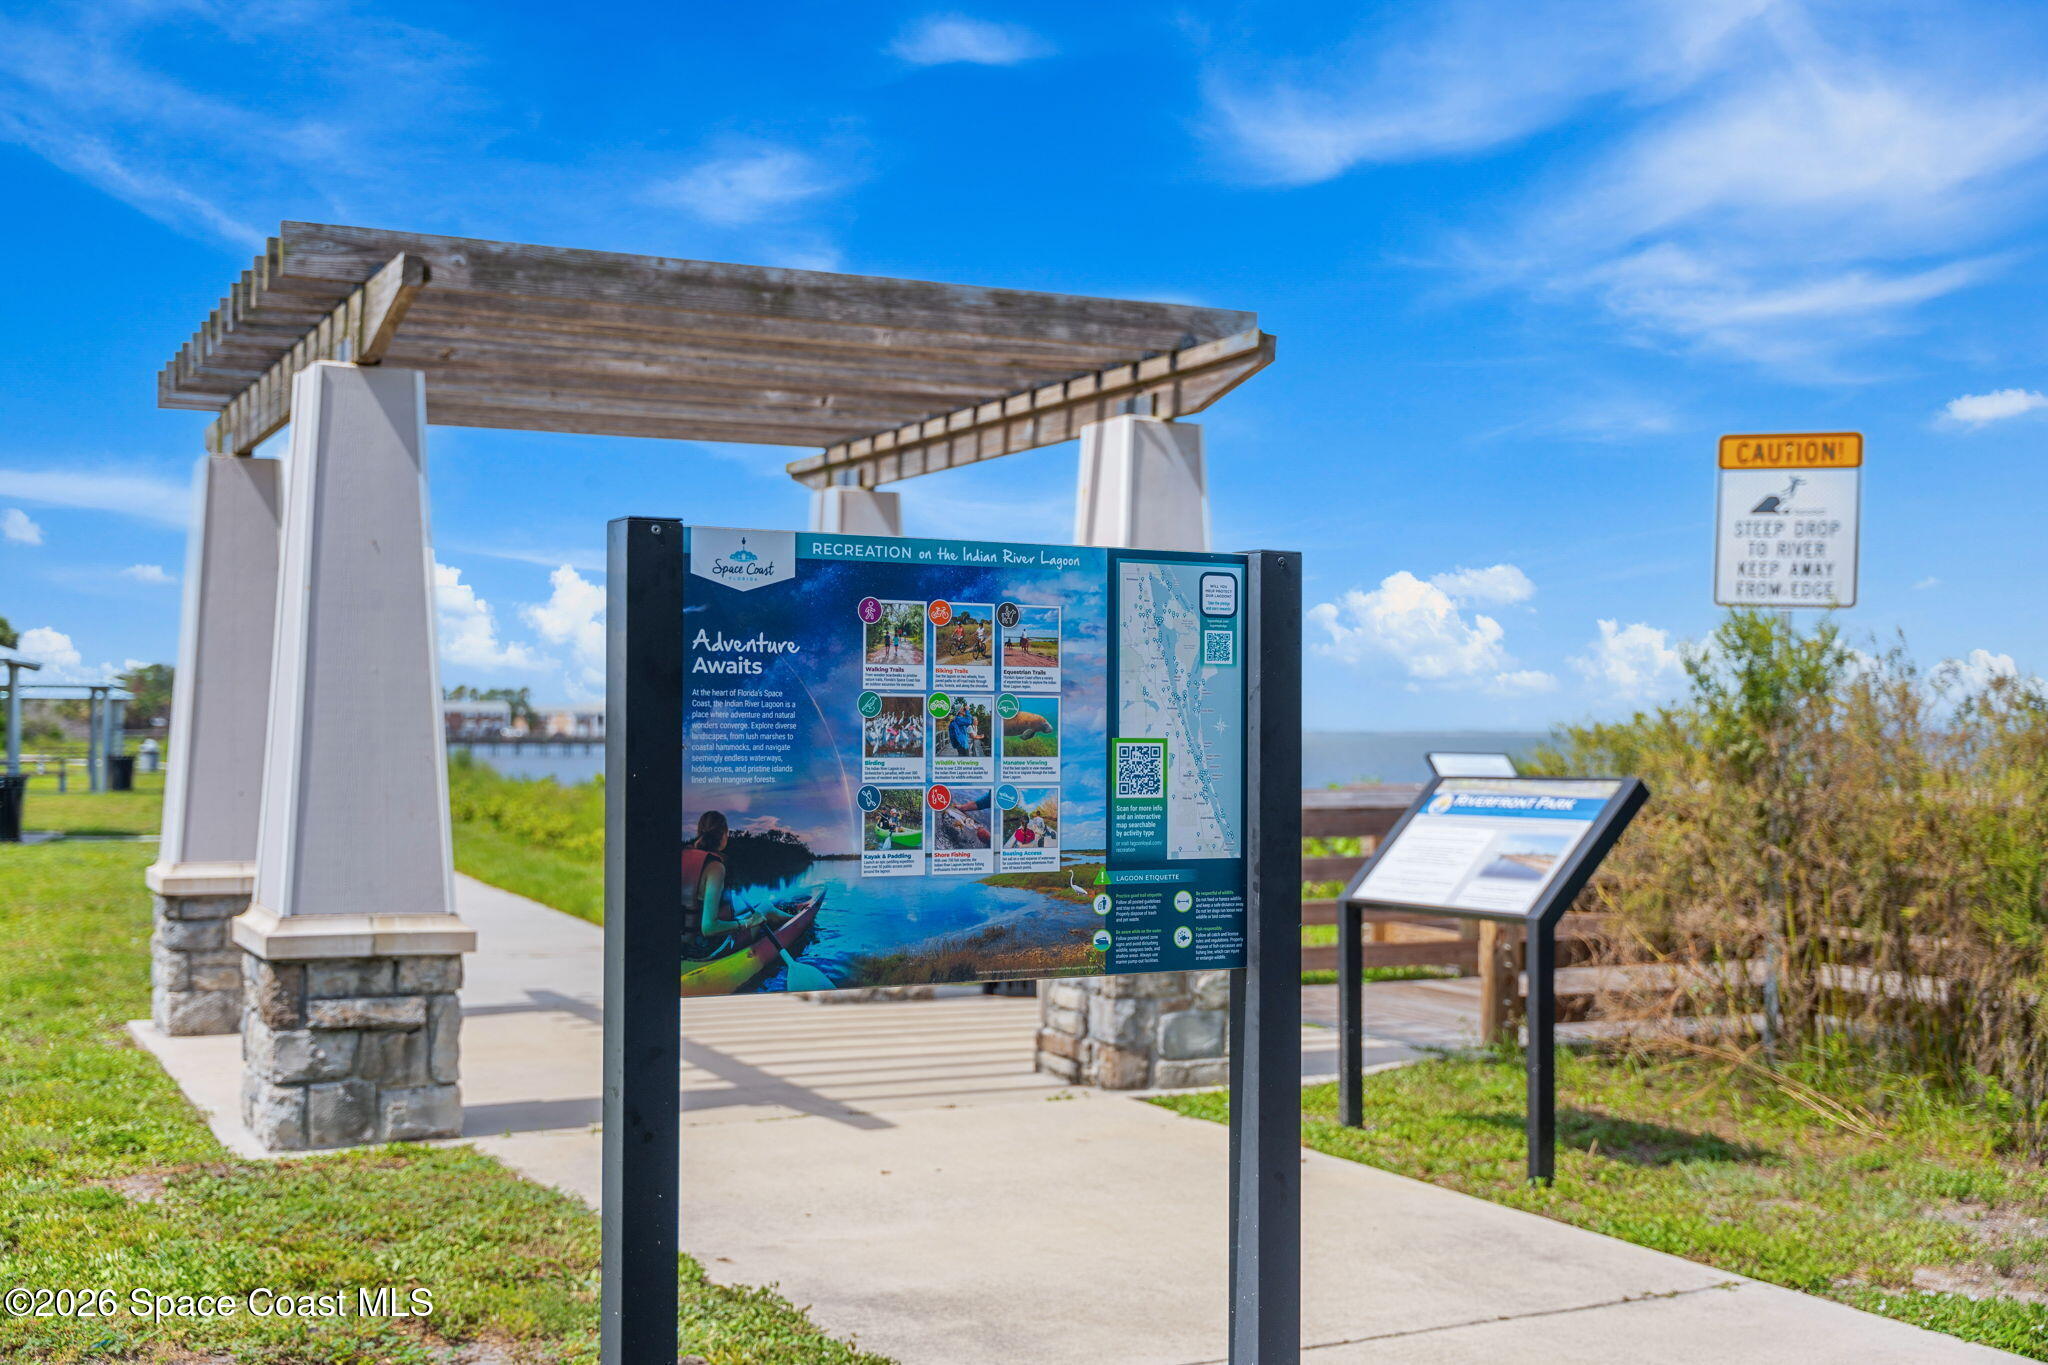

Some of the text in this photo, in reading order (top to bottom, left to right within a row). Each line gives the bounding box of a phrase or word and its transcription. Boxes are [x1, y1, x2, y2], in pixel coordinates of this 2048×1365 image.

[1736, 441, 1844, 464] CAUTION!
[1734, 520, 1840, 538] STEEP DROP
[812, 542, 1080, 570] RECREATION on the Indian River Lagoon
[1749, 541, 1826, 556] TO RIVER
[712, 558, 774, 578] Space Coast
[1737, 561, 1835, 577] KEEP AWAY
[1735, 581, 1835, 598] FROM EDGE
[692, 628, 800, 654] Adventure
[692, 656, 762, 674] Awaits
[738, 689, 762, 697] Florida's
[764, 689, 783, 698] Space
[1453, 794, 1578, 810] RIVERFRONT PARK
